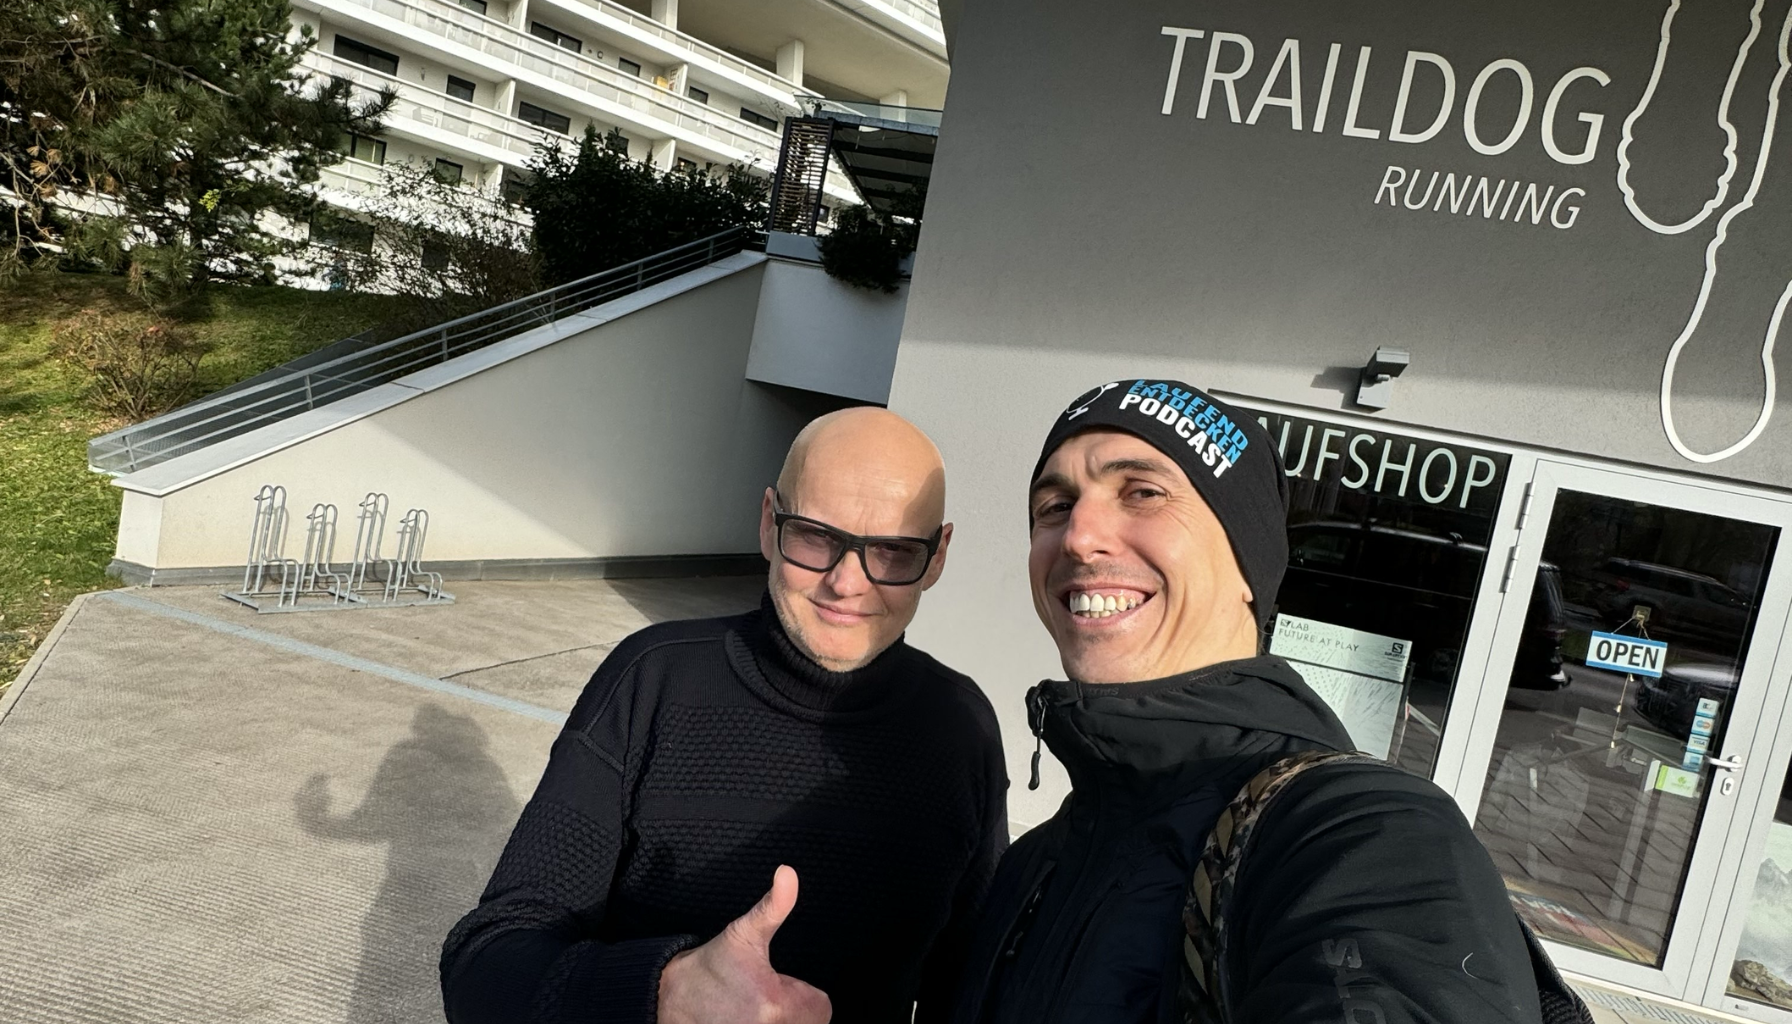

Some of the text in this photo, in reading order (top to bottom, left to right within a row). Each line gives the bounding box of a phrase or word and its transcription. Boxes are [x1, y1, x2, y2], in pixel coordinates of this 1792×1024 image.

[1160, 25, 1612, 165] TRAILDOG
[1374, 165, 1587, 229] RUNNING
[1118, 393, 1233, 479] PODCAST
[1127, 385, 1242, 465] ENTDECKEN
[1132, 379, 1249, 451] LAUFEND
[1257, 416, 1497, 509] UFSHOP
[1279, 628, 1360, 652] FUTURE AT PLAY
[1595, 640, 1660, 670] OPEN
